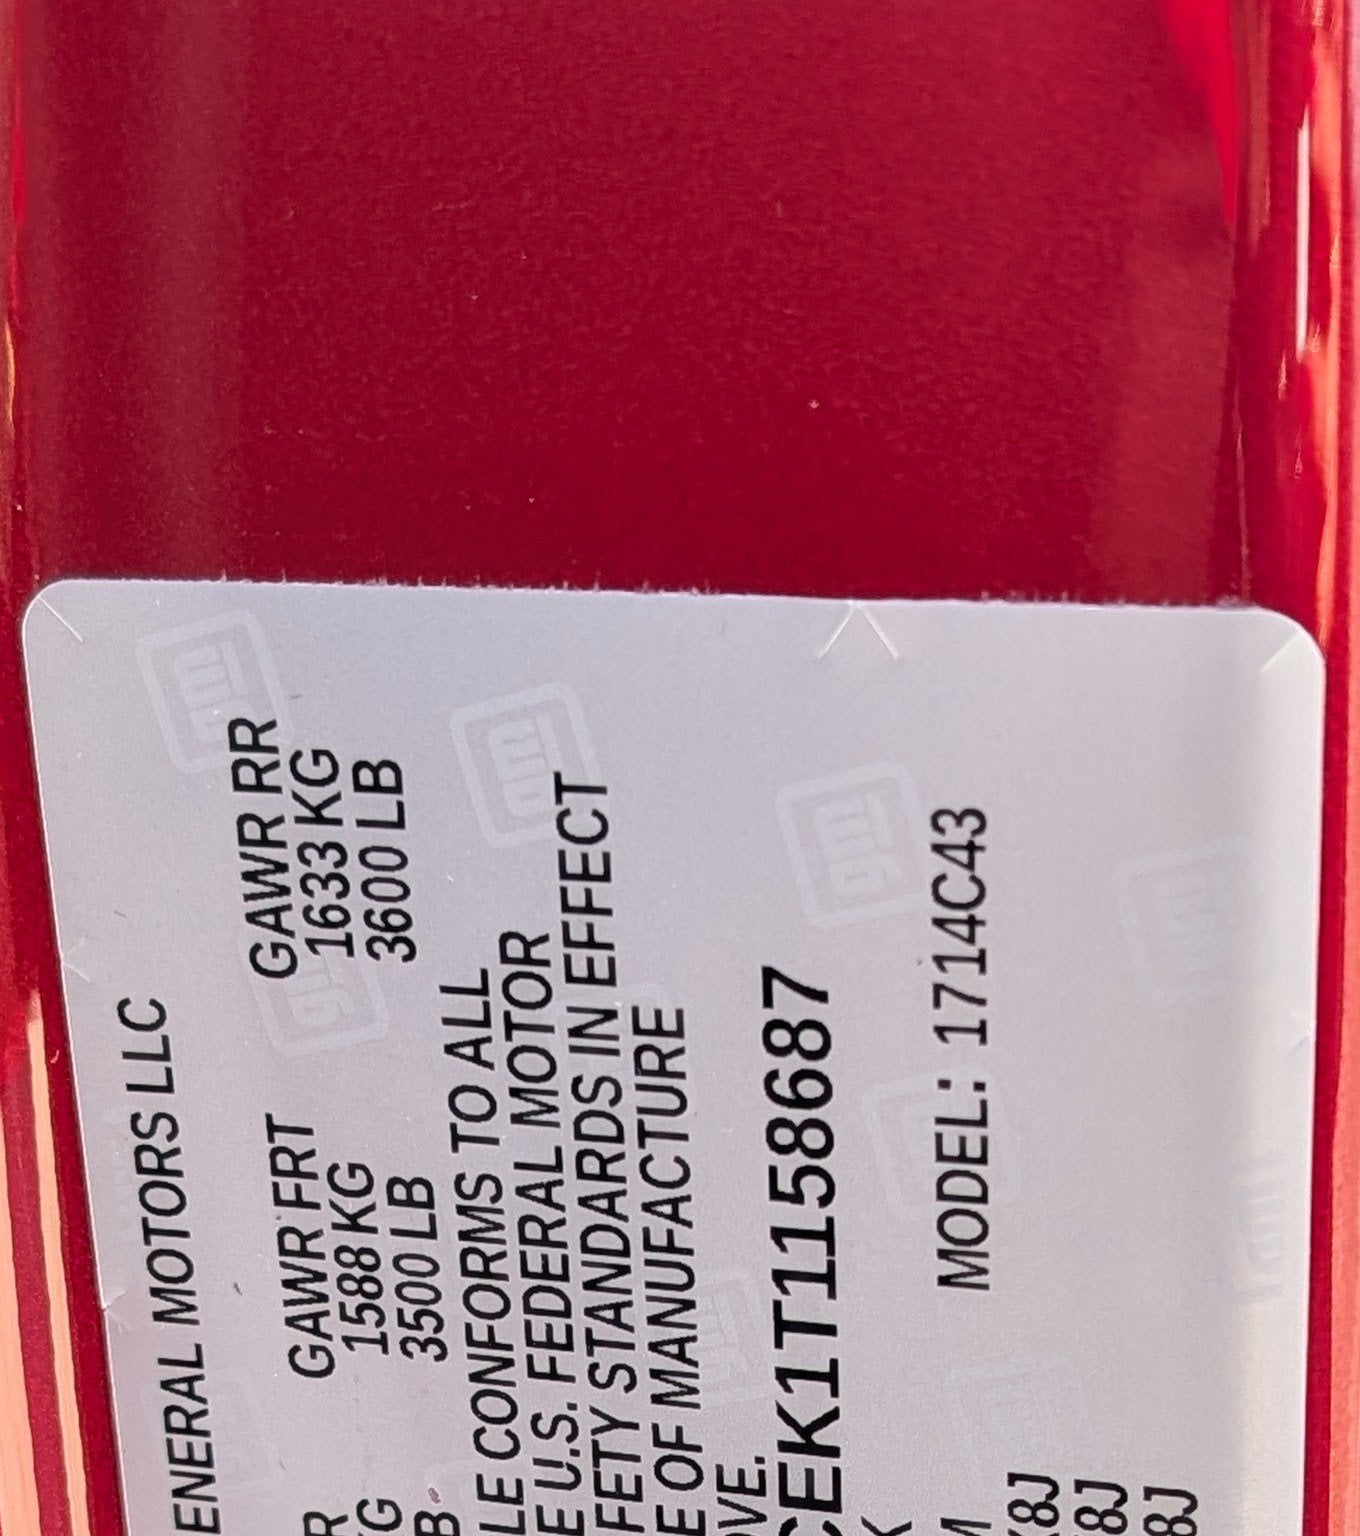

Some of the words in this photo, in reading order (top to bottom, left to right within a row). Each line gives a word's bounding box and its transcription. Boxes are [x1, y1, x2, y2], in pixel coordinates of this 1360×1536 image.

[226, 717, 284, 795] RR
[288, 748, 344, 827] KG
[350, 758, 407, 831] LB
[235, 812, 299, 980] GAWR
[296, 840, 355, 958] 1633
[357, 845, 417, 964] 3600
[552, 770, 618, 988] EFFECT
[929, 807, 988, 1046] 1714C43
[116, 996, 175, 1095] LLC
[438, 967, 496, 1072] ALL
[498, 930, 561, 1129] MOTOR
[565, 1005, 621, 1058] IN
[264, 1112, 322, 1211] FRT
[447, 1083, 500, 1154] TO
[129, 1111, 201, 1326] MOTORS
[326, 1162, 379, 1235] KG
[385, 1175, 438, 1241] LB
[570, 1074, 638, 1395] STANDARDS
[630, 1004, 702, 1410] MANUFACTURE
[934, 1078, 990, 1292] MODEL:
[276, 1225, 336, 1379] GAWR
[333, 1244, 390, 1356] 1588
[391, 1252, 449, 1363] 3500
[453, 1171, 522, 1461] CONFORMS
[512, 1145, 577, 1384] FEDERAL
[529, 1401, 583, 1492] U.S.
[651, 1421, 705, 1492] OF
